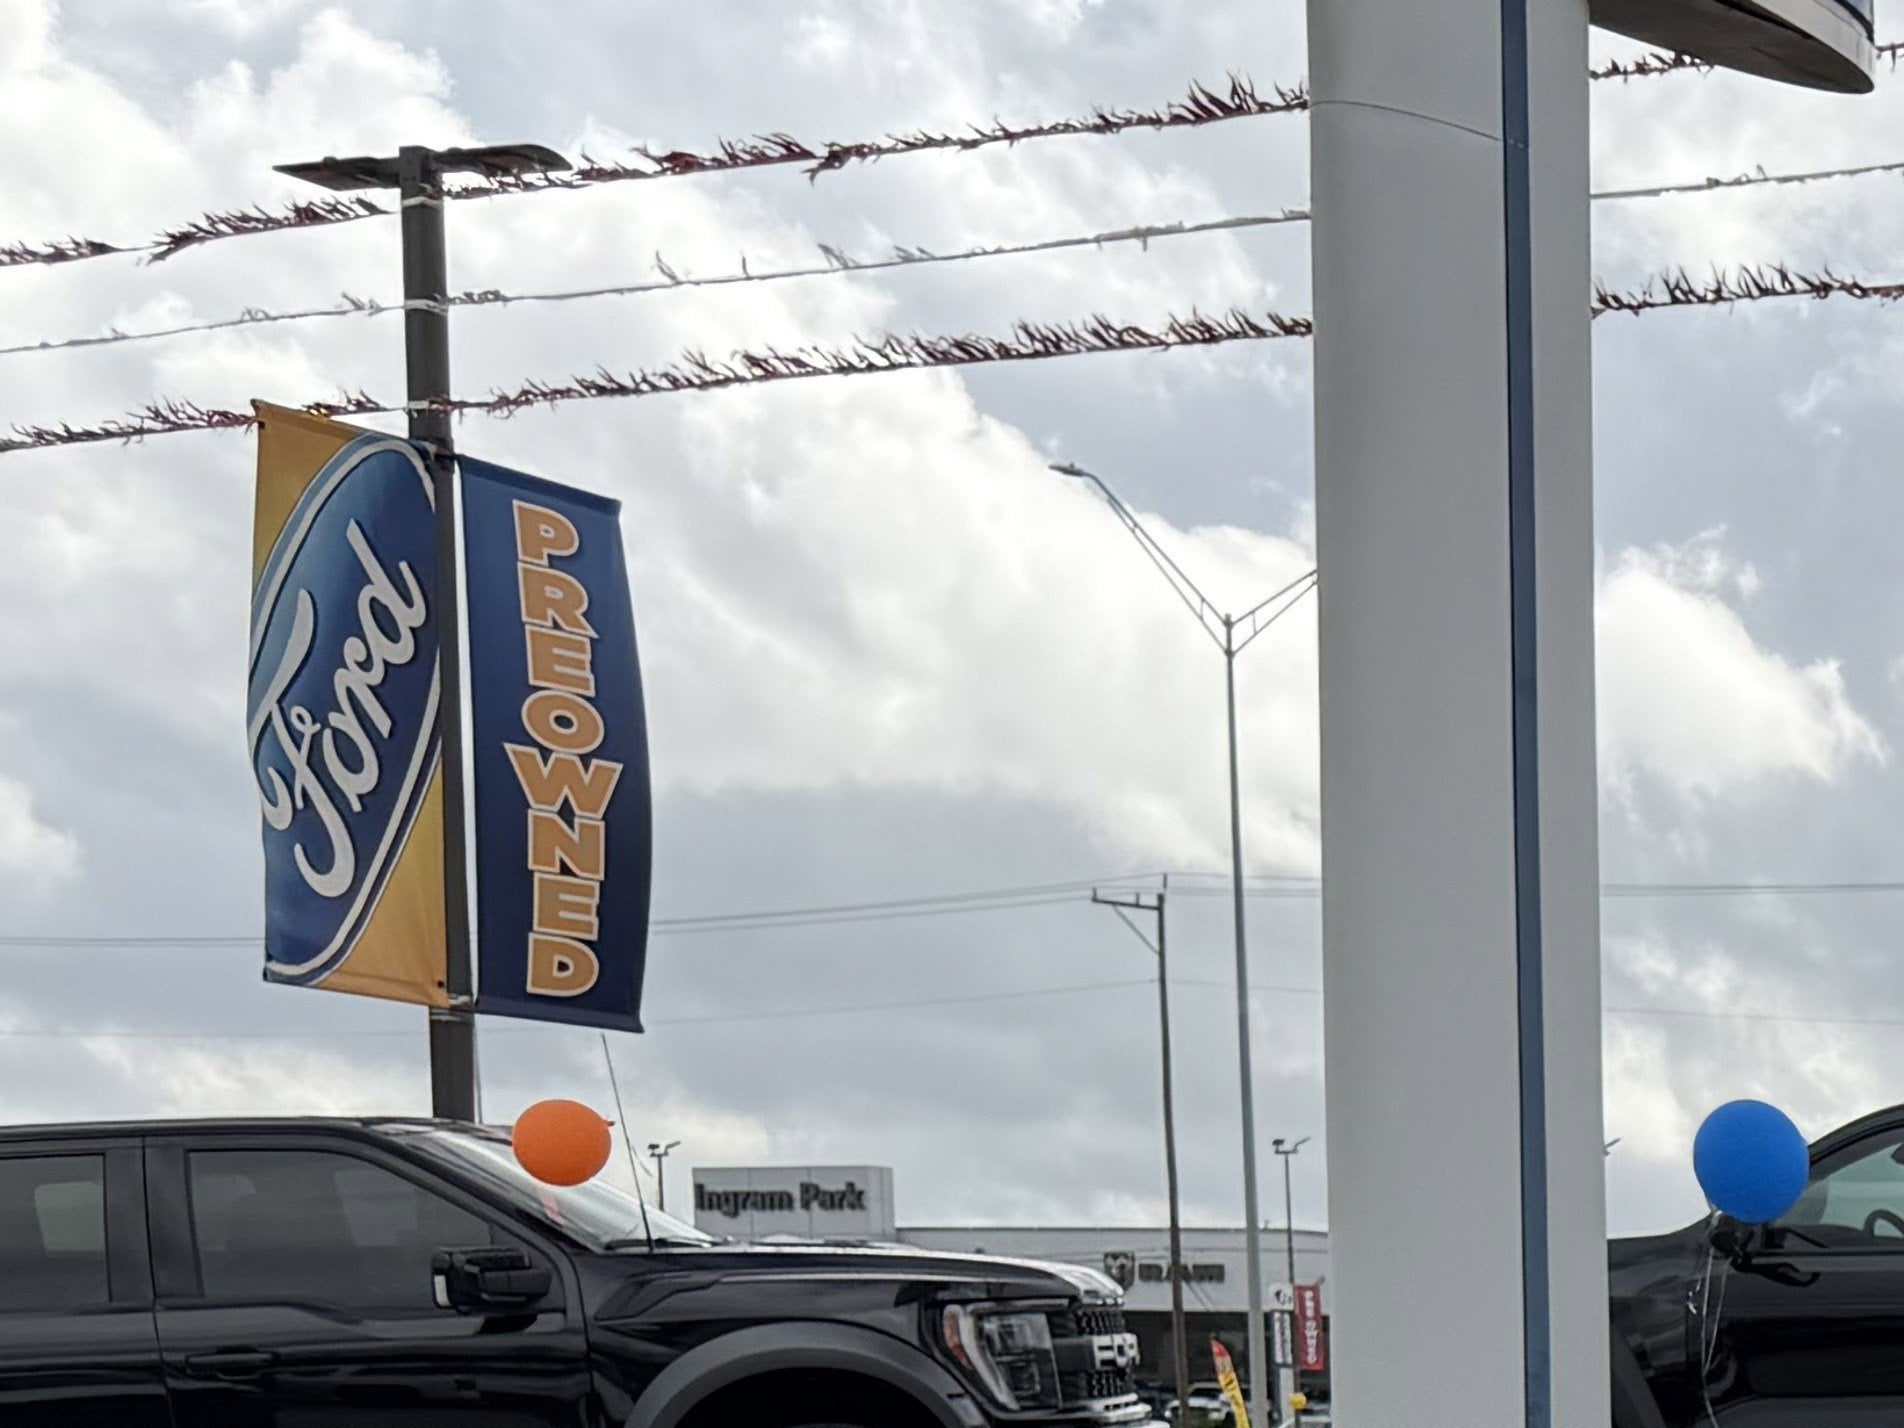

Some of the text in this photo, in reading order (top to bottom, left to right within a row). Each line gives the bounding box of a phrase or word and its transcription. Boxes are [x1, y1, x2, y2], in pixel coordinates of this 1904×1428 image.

[250, 517, 428, 899] Ford
[503, 499, 625, 998] PREOWNED
[694, 1181, 866, 1218] Ingram Park
